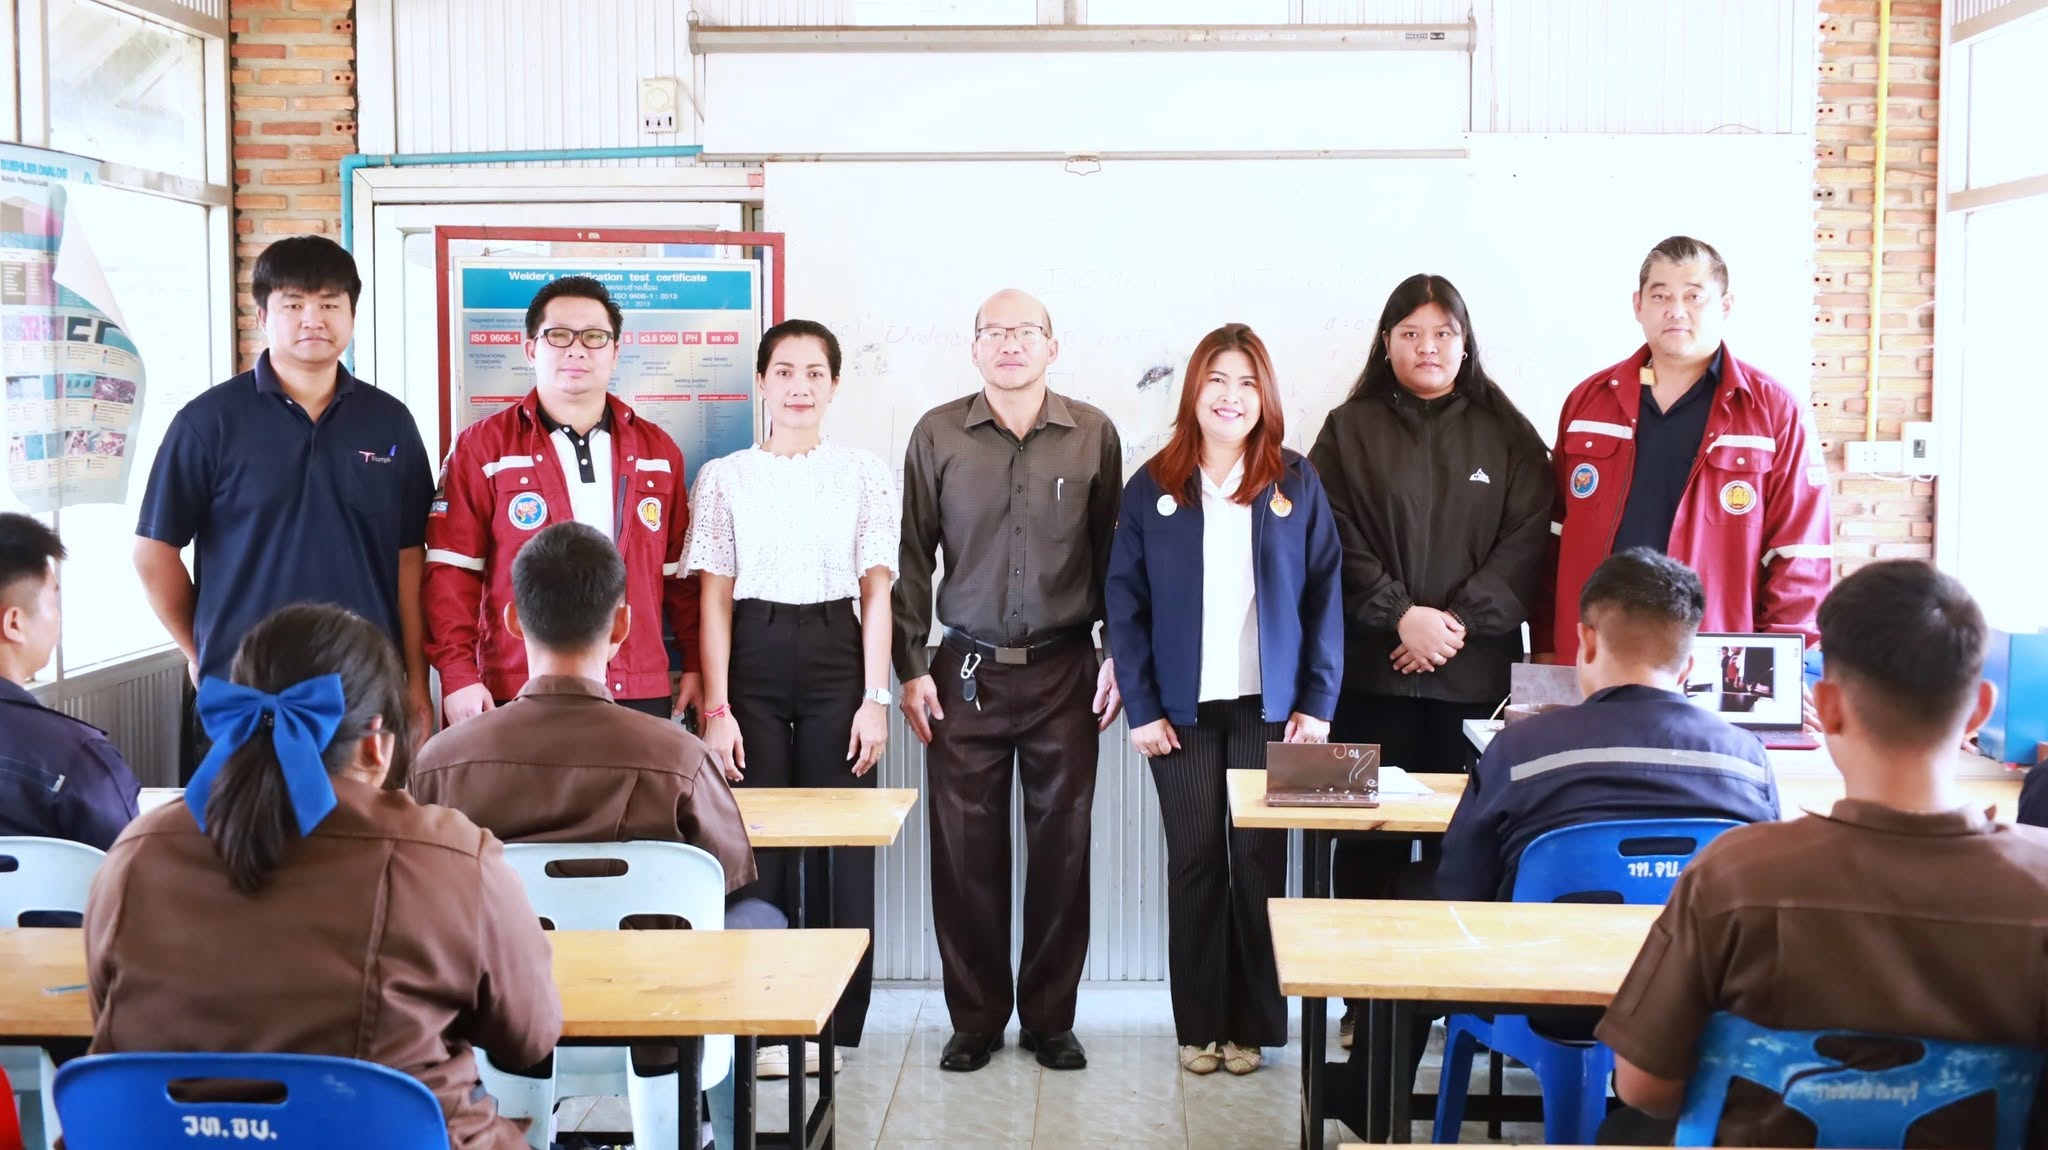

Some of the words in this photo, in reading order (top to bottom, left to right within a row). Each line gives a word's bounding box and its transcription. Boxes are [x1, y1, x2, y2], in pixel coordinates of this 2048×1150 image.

[508, 271, 555, 281] Welder's
[630, 272, 650, 282] test
[656, 272, 707, 282] certificate
[470, 333, 487, 342] ISO
[489, 333, 519, 342] 9606-1
[624, 334, 632, 343] S
[685, 334, 698, 342] PH
[723, 334, 735, 342] nb
